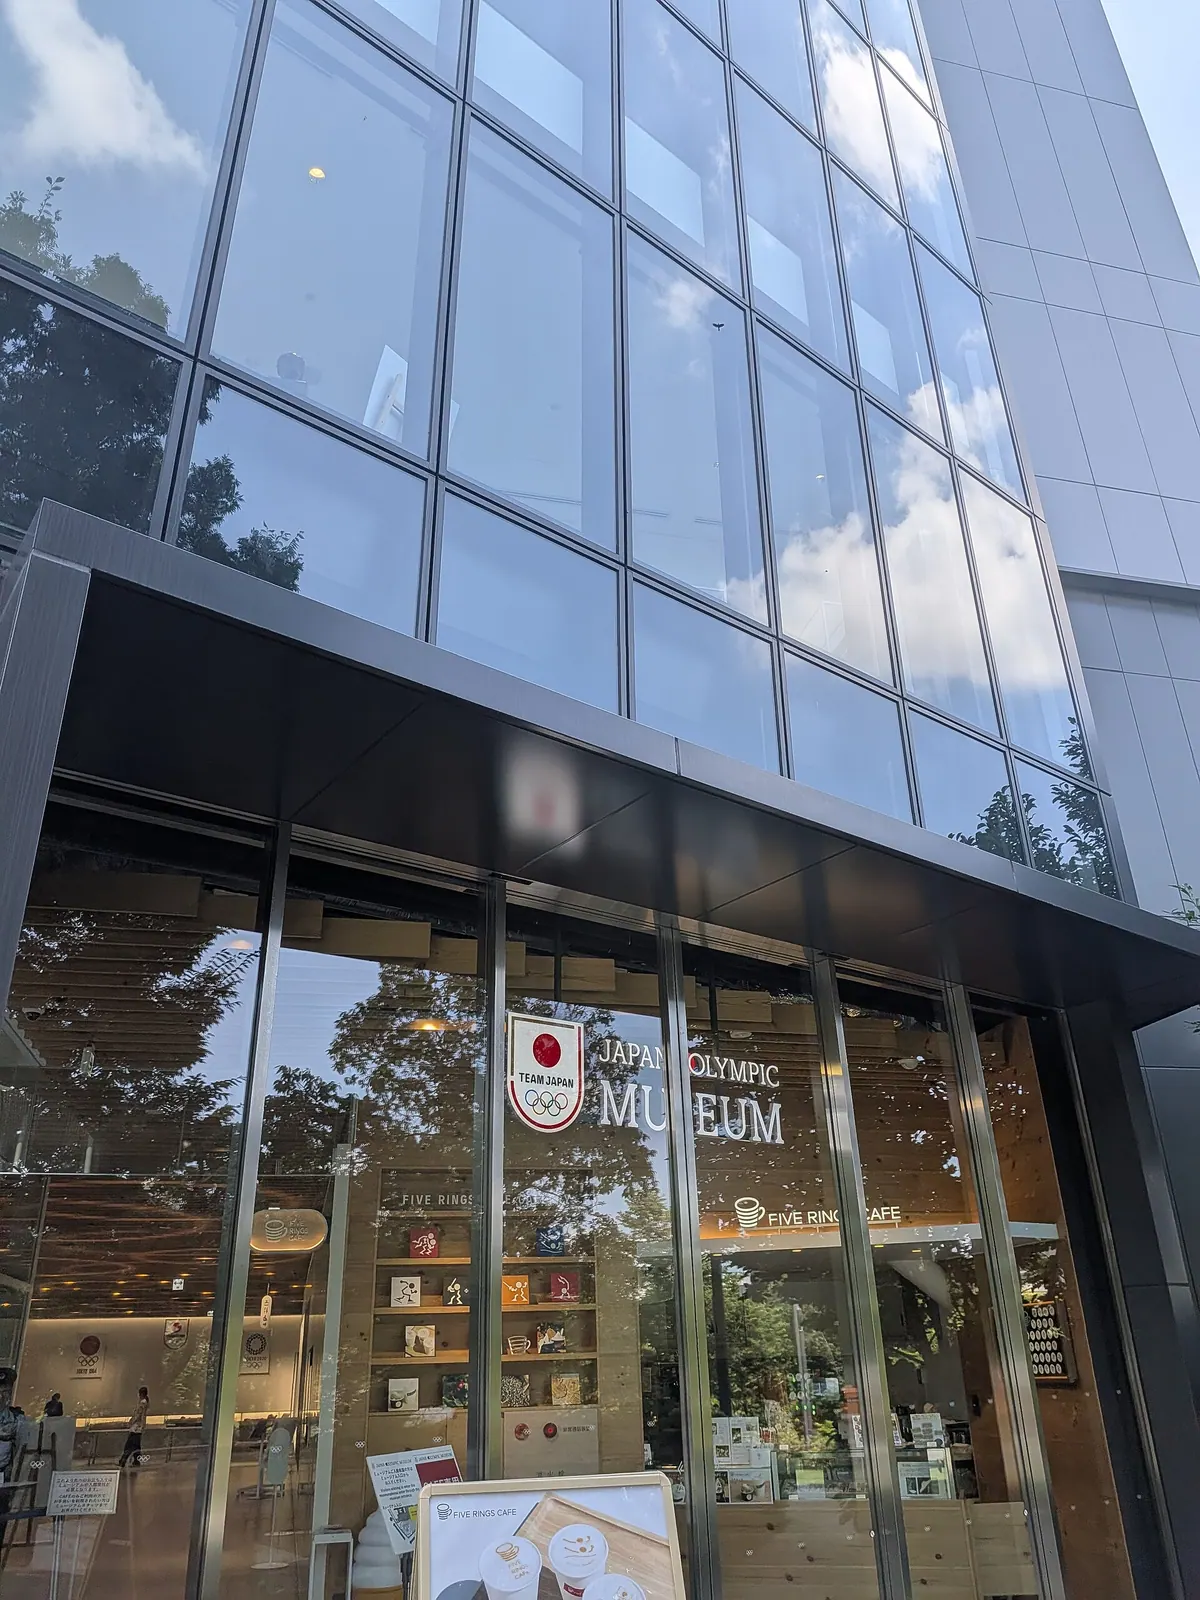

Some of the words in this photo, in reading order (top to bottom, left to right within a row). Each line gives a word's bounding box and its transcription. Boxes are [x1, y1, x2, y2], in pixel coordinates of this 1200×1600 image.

[688, 1052, 780, 1088] OLYMPIC
[518, 1072, 544, 1085] TEAM
[545, 1075, 574, 1089] JAPAN
[600, 1079, 784, 1145] MUEUM
[402, 1194, 431, 1206] FIVE
[438, 1194, 473, 1206] RINGS
[768, 1211, 802, 1226] FIVE
[807, 1209, 840, 1224] RIN
[497, 1508, 517, 1516] CAFE
